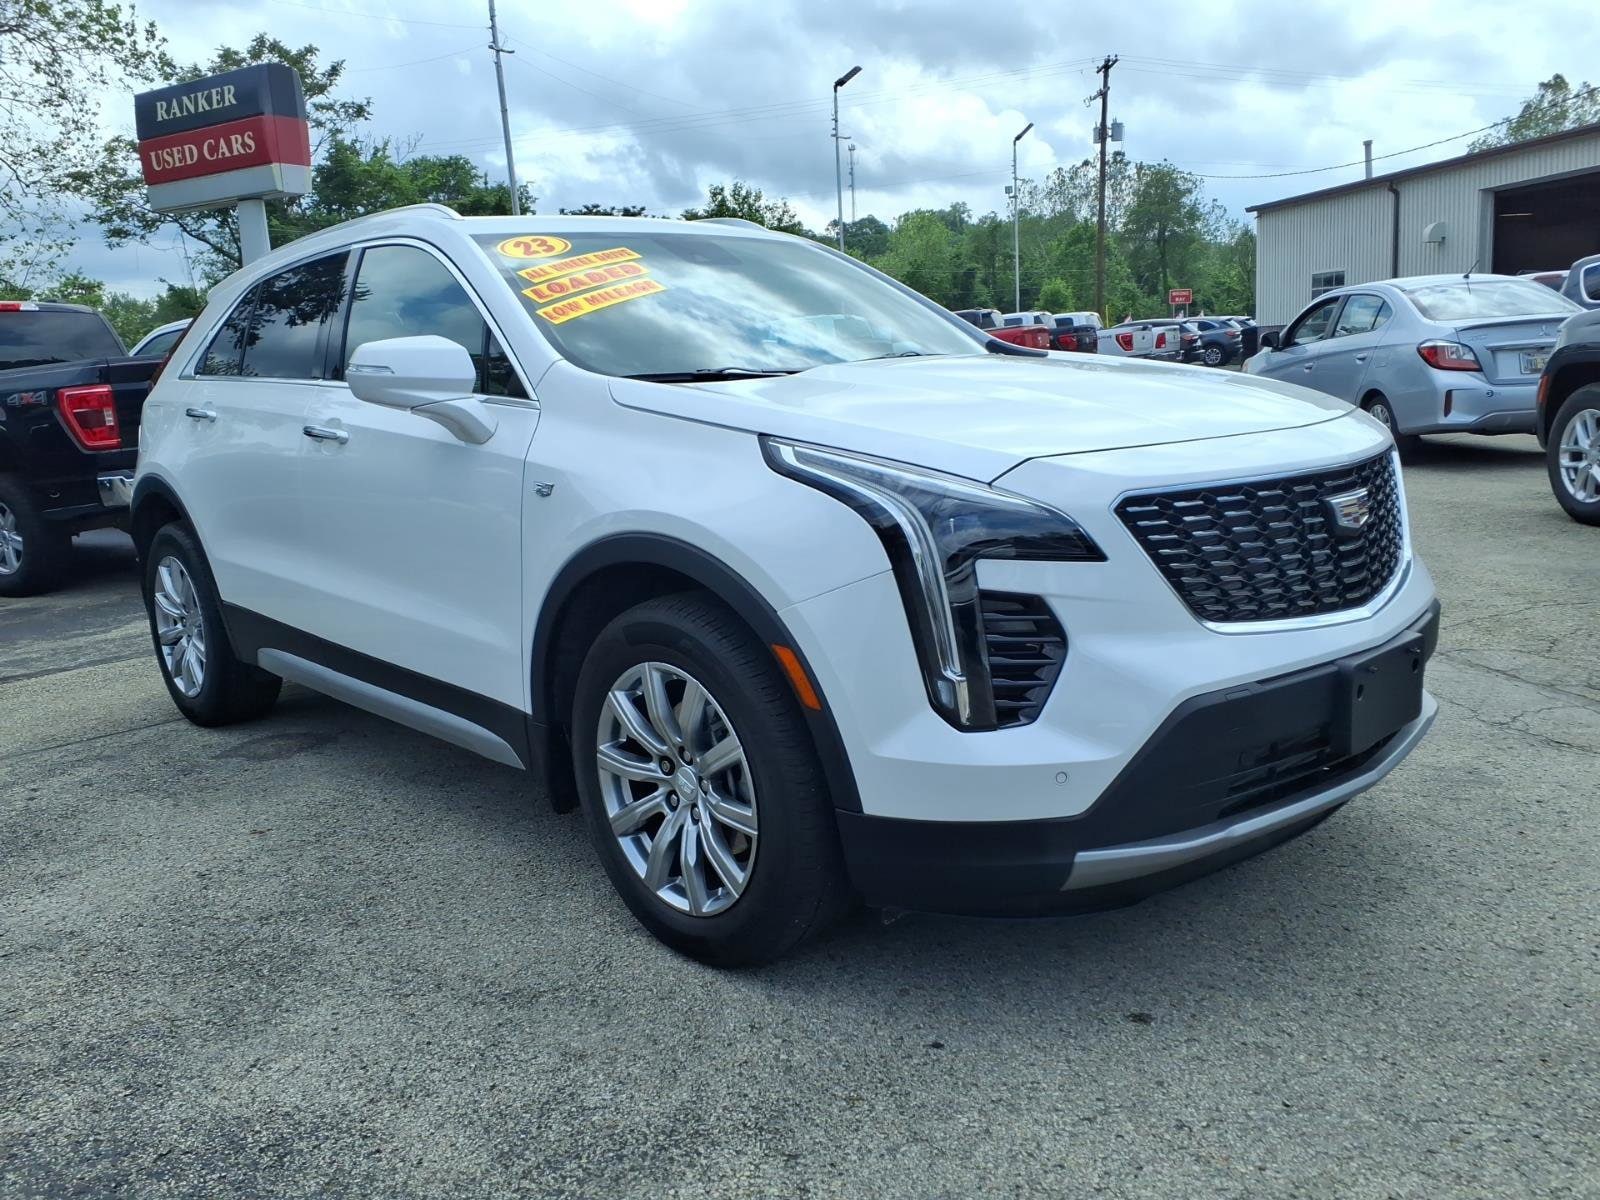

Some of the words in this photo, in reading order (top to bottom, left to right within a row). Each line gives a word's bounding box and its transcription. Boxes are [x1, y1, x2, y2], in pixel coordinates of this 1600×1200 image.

[156, 85, 237, 122] RANKER
[149, 144, 198, 171] USED
[203, 131, 256, 160] CARS
[513, 238, 556, 256] 23
[525, 267, 549, 280] ALL
[550, 254, 592, 271] WHEEL
[594, 248, 632, 262] DRIVE
[530, 264, 642, 300] LOADED
[542, 300, 583, 321] LOW
[583, 280, 658, 306] MILEAGE
